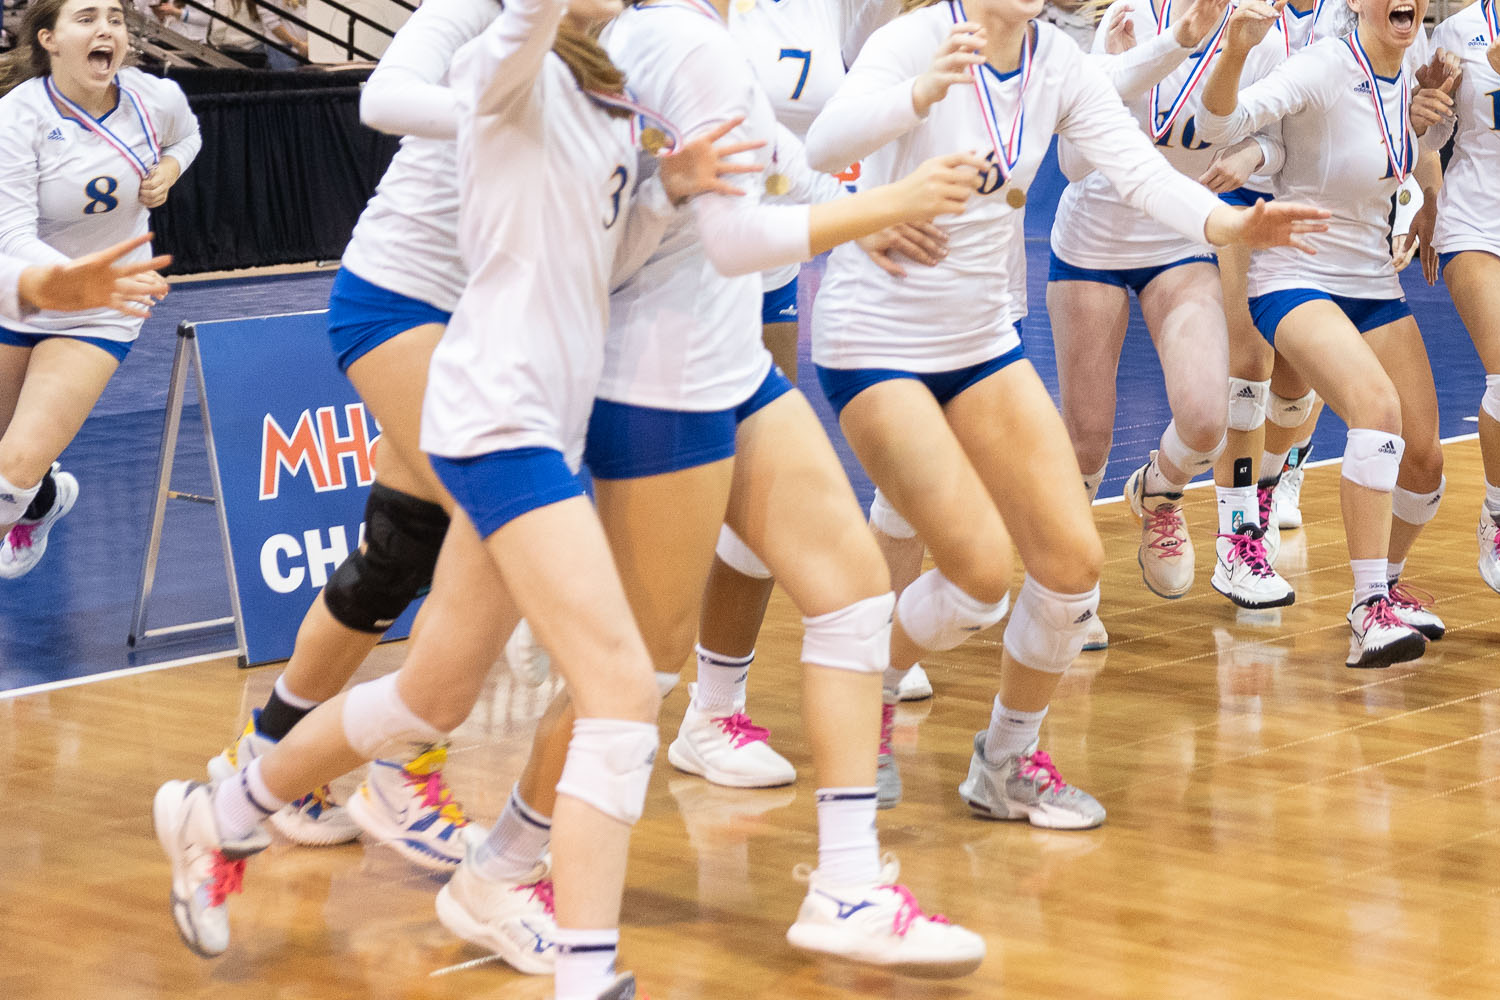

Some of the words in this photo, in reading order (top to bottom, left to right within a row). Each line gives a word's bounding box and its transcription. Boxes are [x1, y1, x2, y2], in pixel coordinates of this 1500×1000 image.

[778, 46, 813, 101] 7
[83, 174, 119, 216] 8
[602, 163, 628, 231] 3
[260, 522, 366, 594] CH
